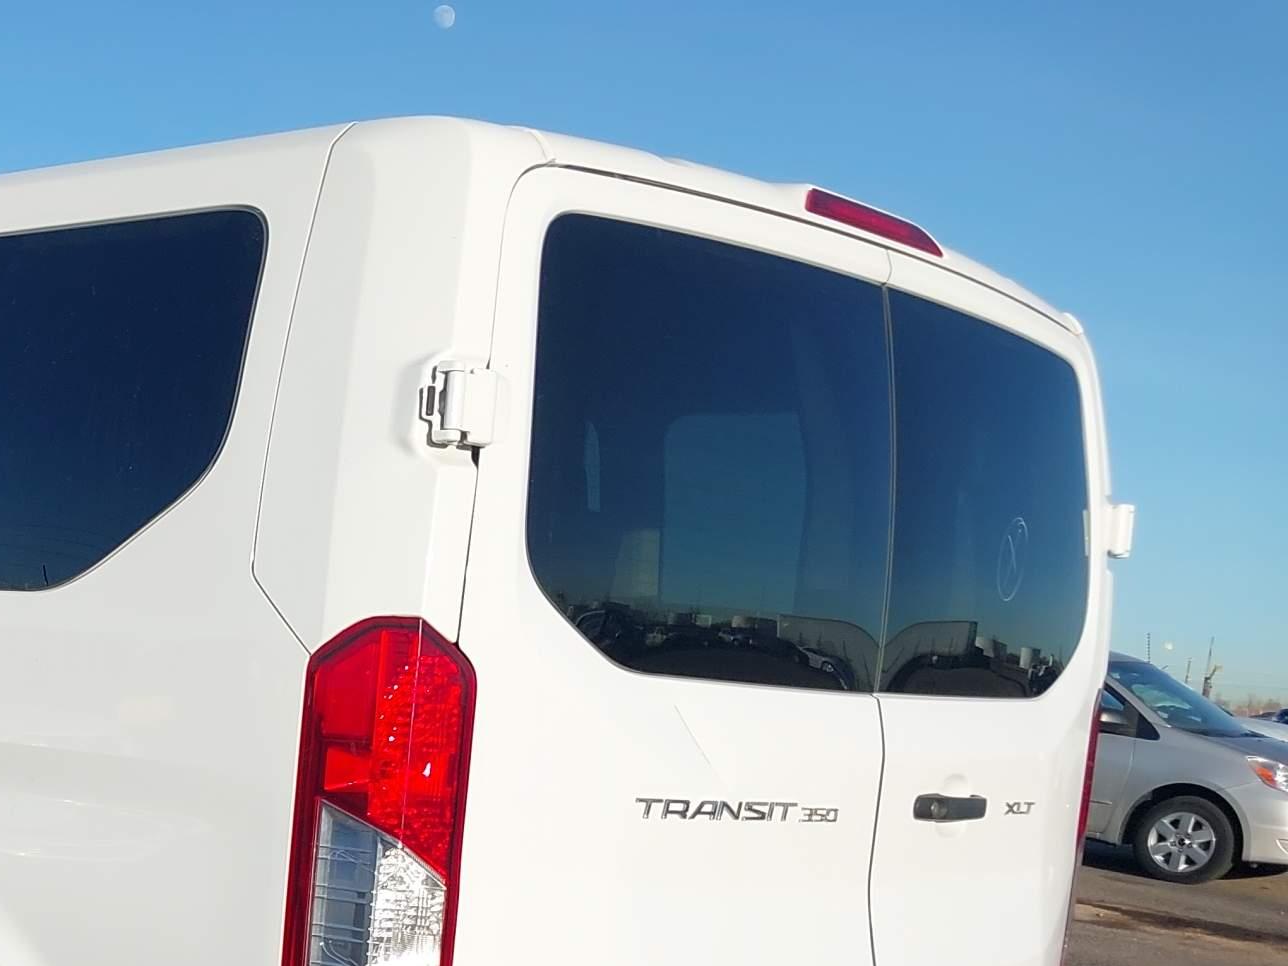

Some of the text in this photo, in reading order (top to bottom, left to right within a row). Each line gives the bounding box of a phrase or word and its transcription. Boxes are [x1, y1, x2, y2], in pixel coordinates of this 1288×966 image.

[636, 798, 838, 823] TRANSIT 350
[1005, 801, 1034, 815] XLT
